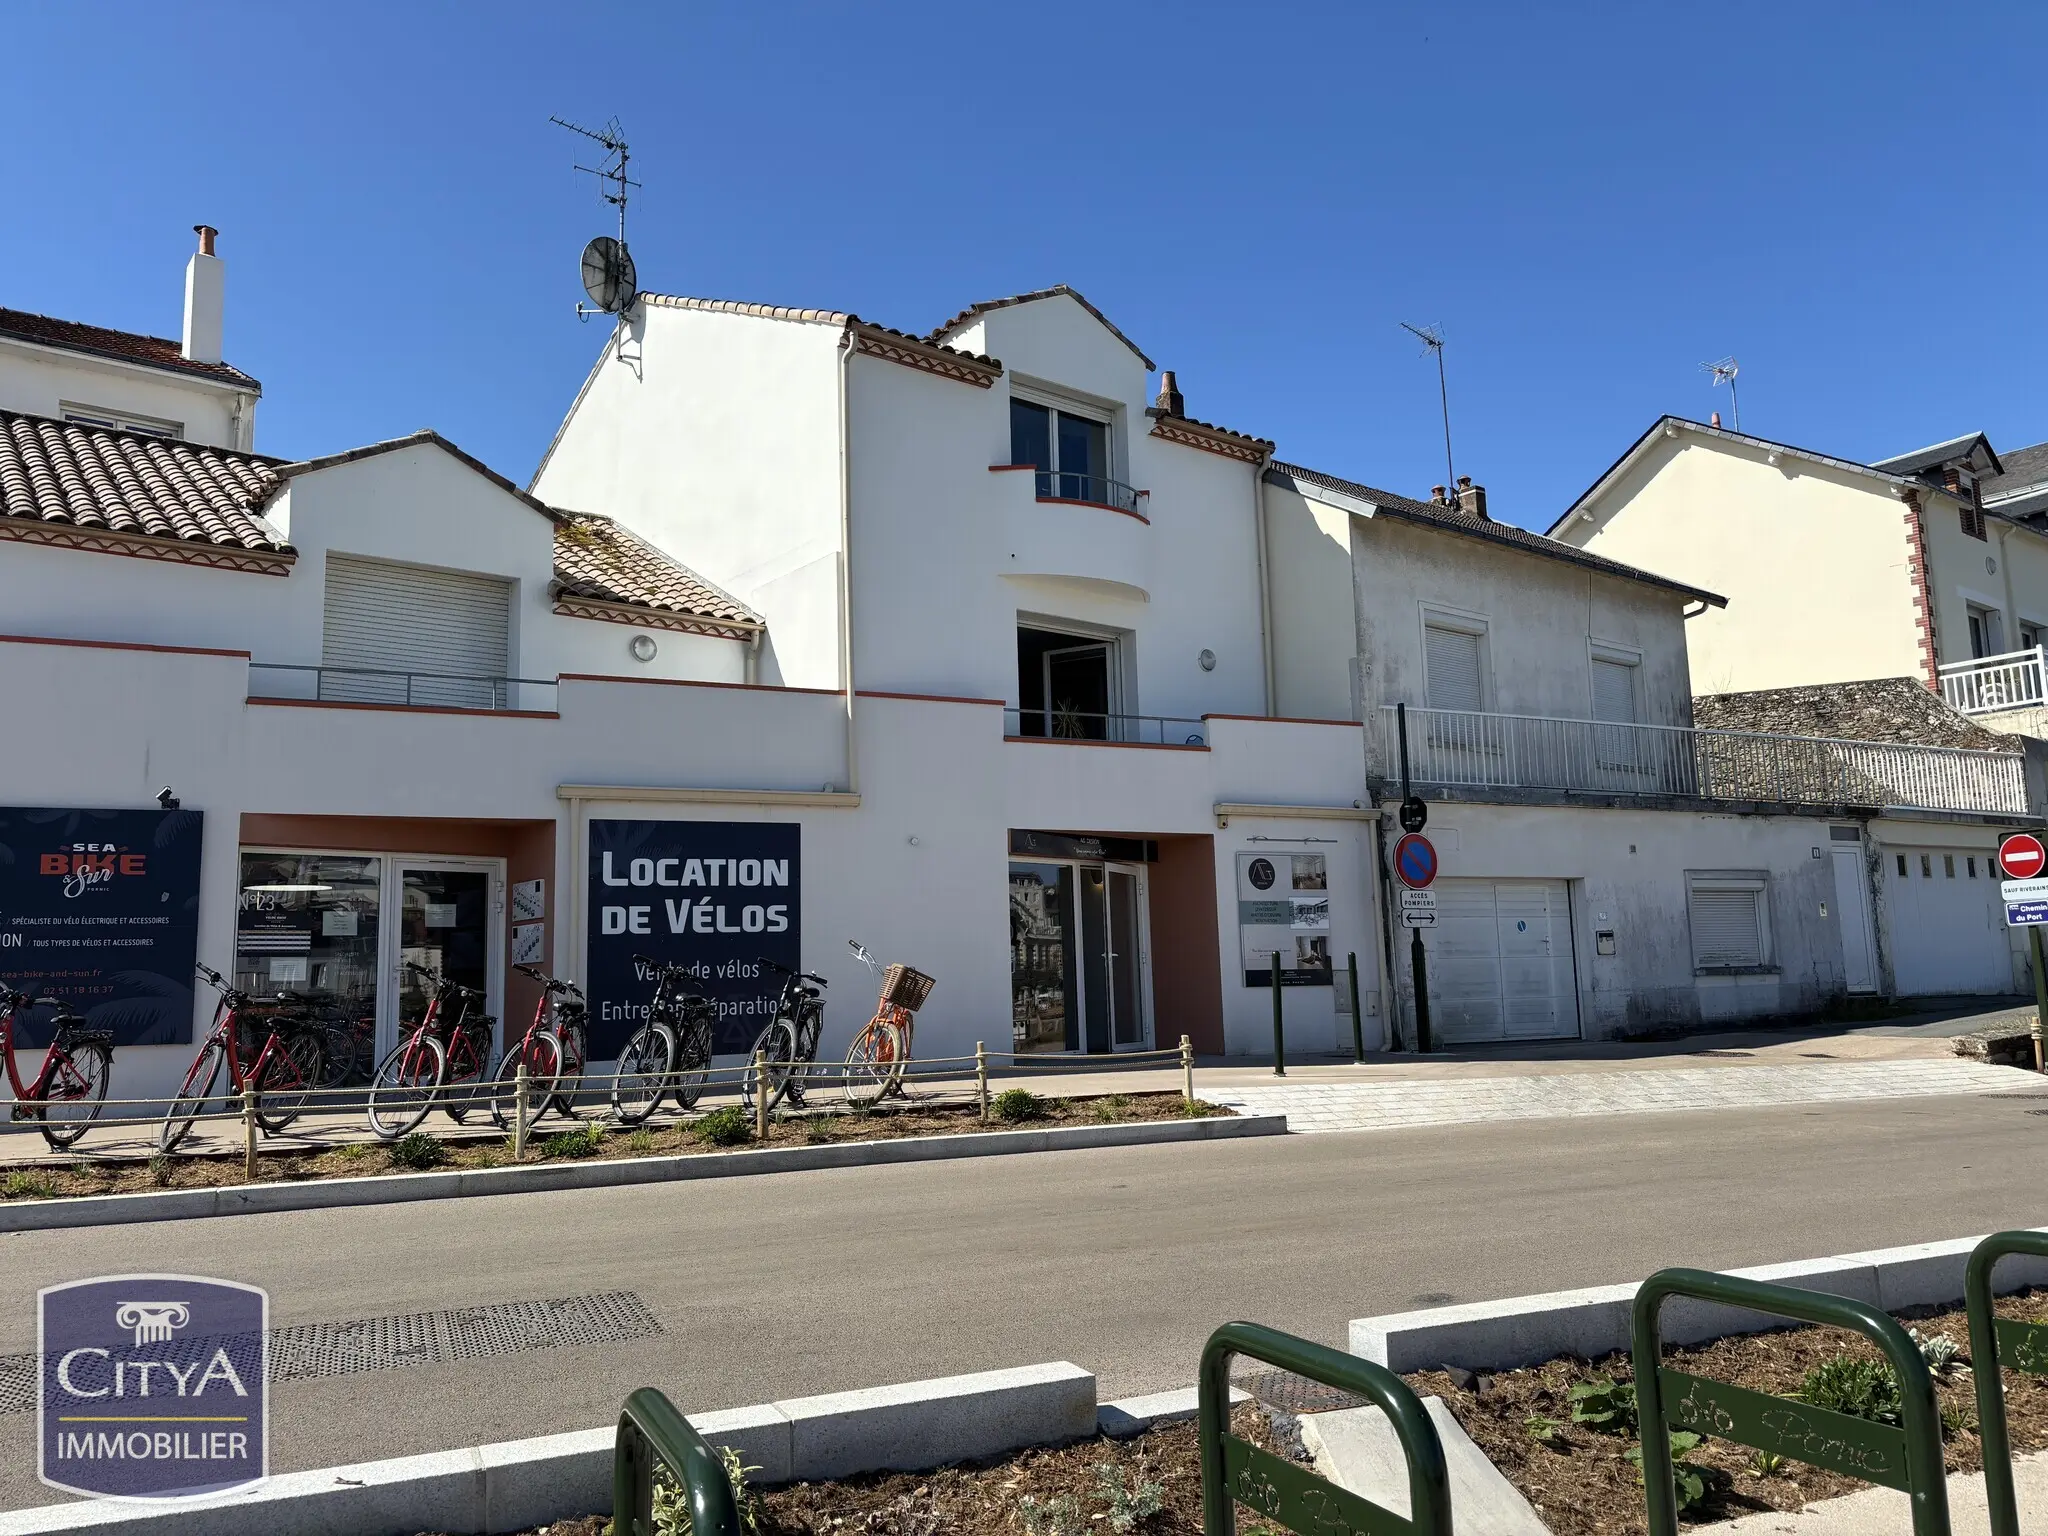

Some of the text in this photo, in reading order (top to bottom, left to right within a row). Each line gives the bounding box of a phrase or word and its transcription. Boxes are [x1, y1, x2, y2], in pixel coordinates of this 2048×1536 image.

[72, 843, 117, 852] SEA
[40, 853, 146, 875] BIKE
[602, 851, 789, 887] LOCATION
[63, 864, 114, 898] Sun
[664, 896, 789, 934] VÉLOS
[2020, 904, 2048, 912] Chemin
[2026, 913, 2043, 921] Port
[12, 916, 52, 925] SPÉCIALISTE
[53, 917, 62, 925] DU
[64, 916, 80, 925] VÉLO
[81, 915, 119, 925] ÉLECTRIQUE
[119, 917, 127, 925] ET
[128, 916, 170, 925] ACCESSOIRES
[33, 939, 49, 947] TOUS
[51, 939, 71, 947] TYPES
[72, 939, 81, 947] DE
[82, 937, 102, 947] VÉLOS
[103, 939, 111, 947] ET
[112, 938, 154, 947] ACCESSOIRES
[691, 960, 710, 980] de
[716, 958, 760, 979] vélos
[1761, 1409, 1893, 1473] Pornic
